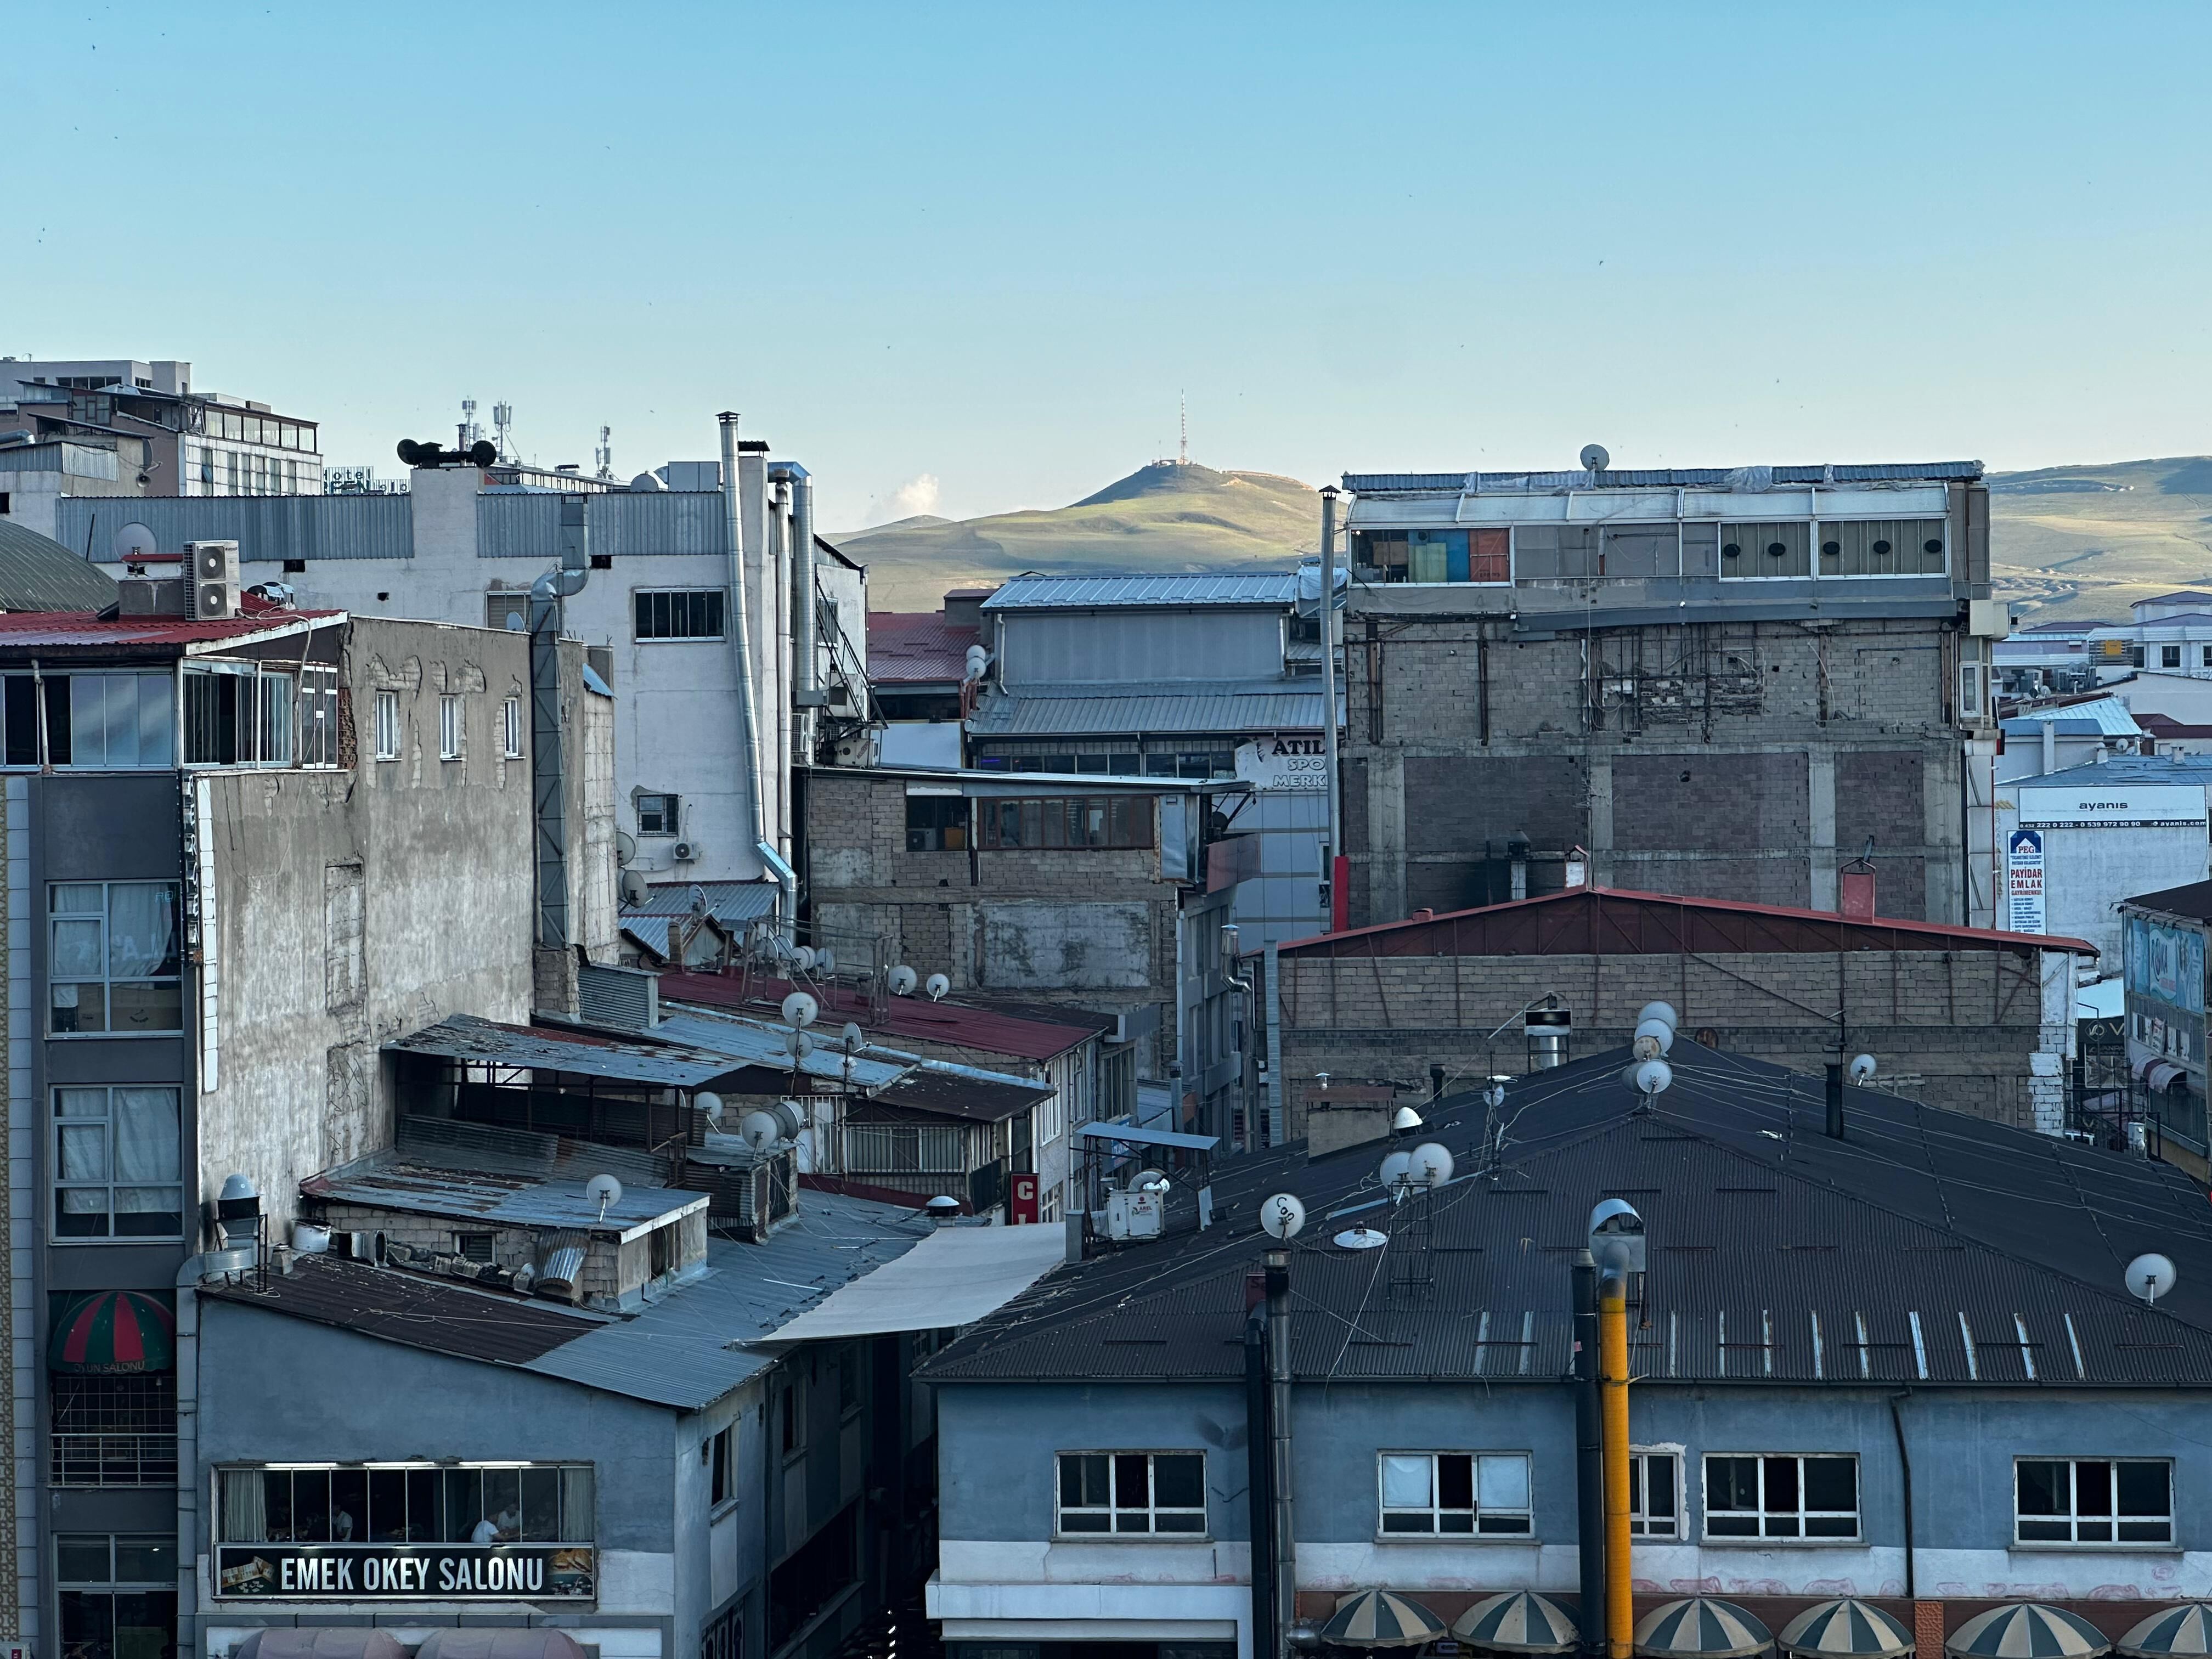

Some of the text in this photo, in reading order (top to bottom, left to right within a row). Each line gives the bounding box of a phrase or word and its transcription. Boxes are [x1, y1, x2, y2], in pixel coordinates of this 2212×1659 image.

[2018, 845, 2035, 854] PEG
[2011, 867, 2042, 878] PAYİDAR
[2011, 879, 2042, 889] EMLAK
[2109, 1022, 2124, 1036] V
[103, 1361, 145, 1372] SALONU
[281, 1558, 543, 1590] EMEK OKEY SALONU
